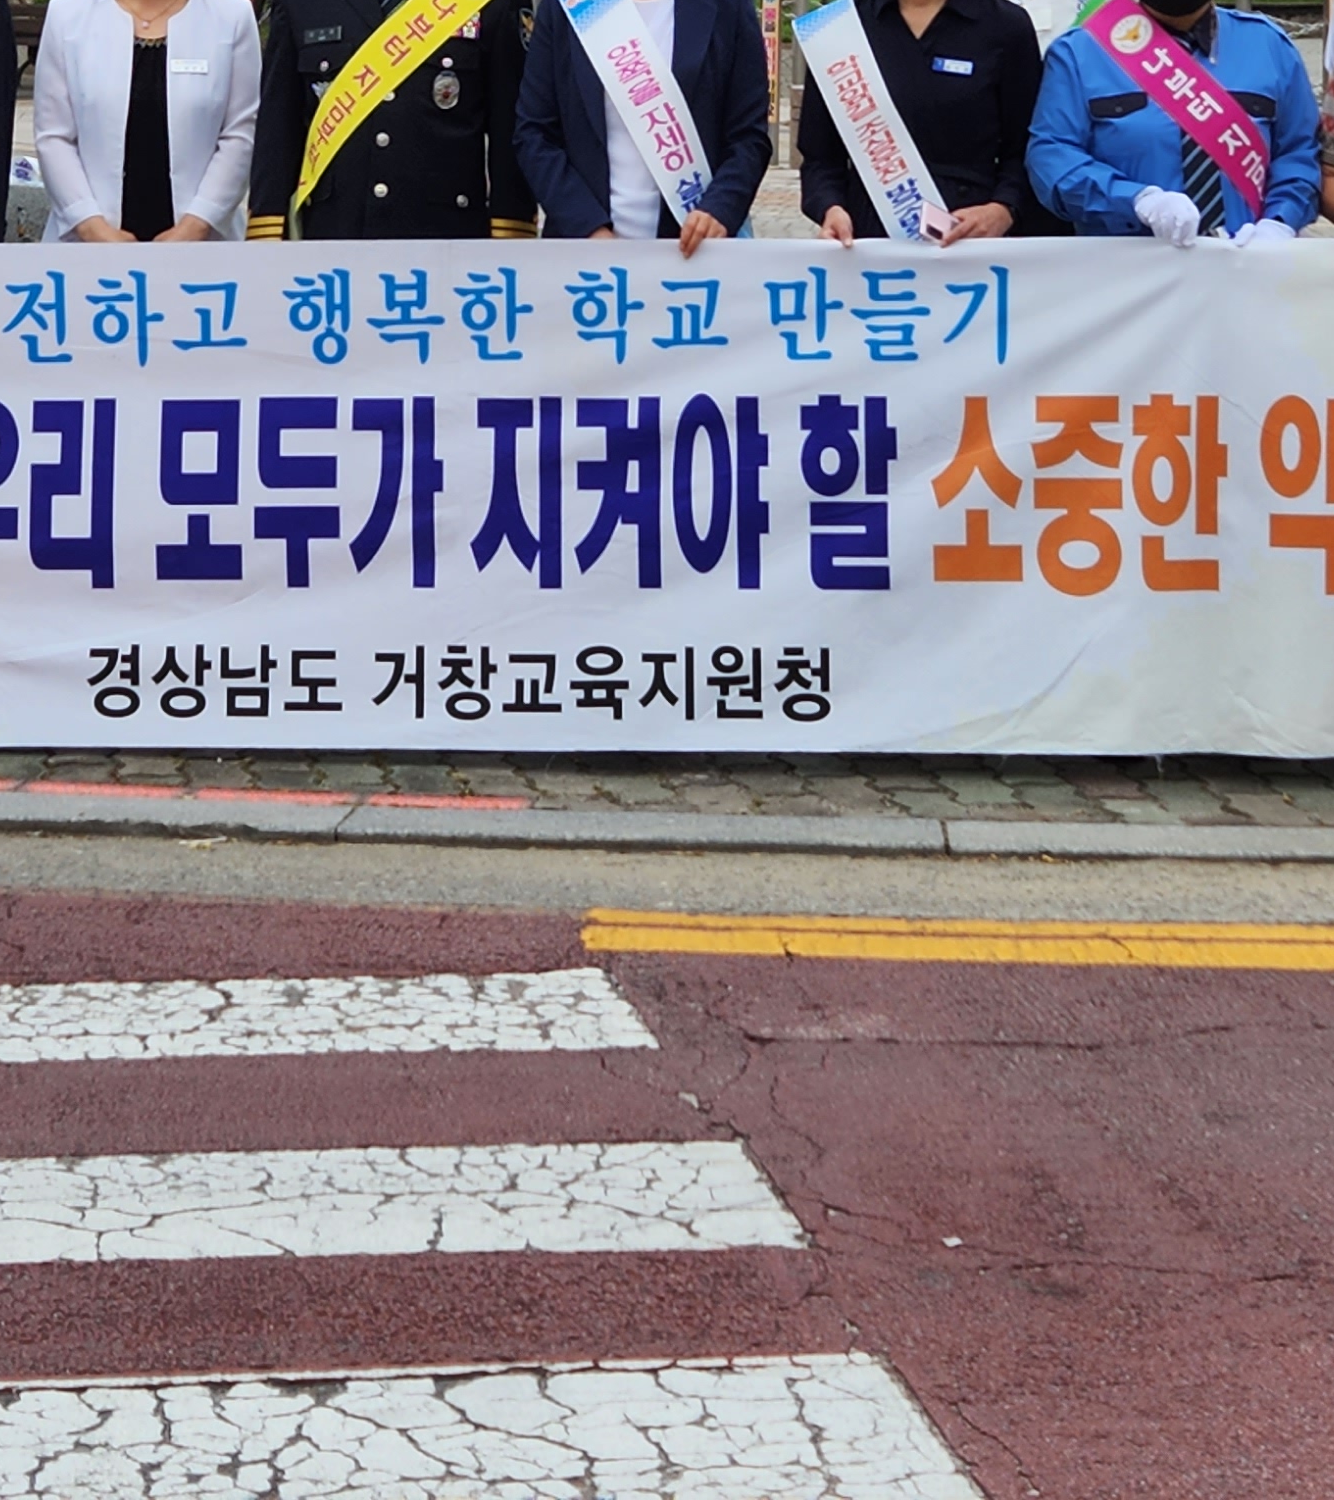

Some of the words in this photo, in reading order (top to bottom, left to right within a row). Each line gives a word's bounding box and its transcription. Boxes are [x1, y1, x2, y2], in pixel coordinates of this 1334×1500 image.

[606, 38, 663, 107] 양쪽을
[640, 102, 694, 172] 자세히
[1142, 46, 1224, 122] 나부터
[1218, 123, 1267, 200] 지금
[284, 266, 534, 365] 행복한
[565, 266, 729, 365] 학교
[765, 264, 1011, 364] 만들기
[156, 395, 445, 590] 모두가
[471, 392, 769, 590] 지켜야
[799, 393, 898, 591] 할
[931, 392, 1229, 596] 소중한
[86, 643, 343, 719] 경상남도
[371, 644, 835, 722] 거창교육지원청
